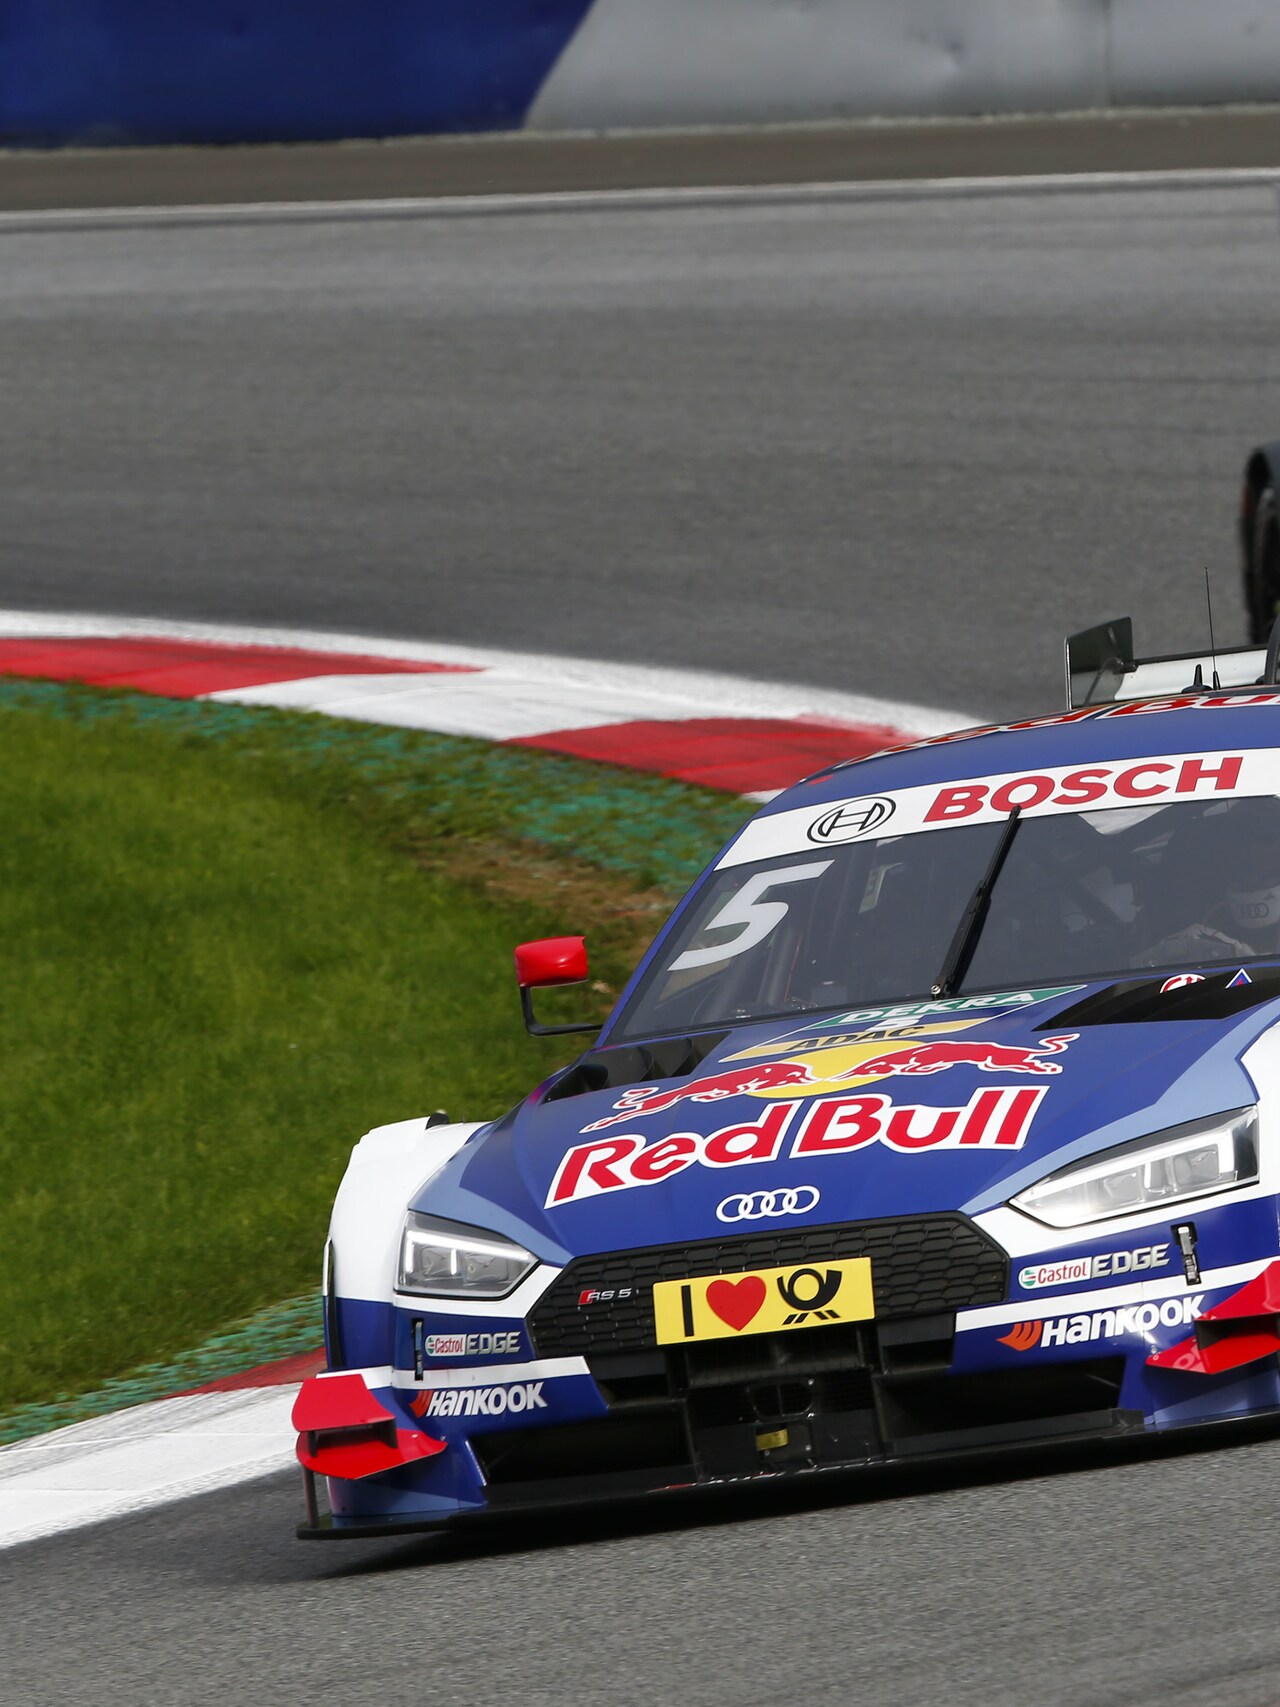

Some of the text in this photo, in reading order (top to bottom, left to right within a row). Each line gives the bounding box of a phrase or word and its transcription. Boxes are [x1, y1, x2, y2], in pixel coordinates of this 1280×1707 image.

[923, 756, 1243, 823] BOSCH
[667, 860, 835, 971] 5
[839, 992, 1035, 1024] DEKRA
[786, 1026, 927, 1050] ADAC
[548, 1087, 1046, 1206] Red Bull
[1037, 1243, 1171, 1285] Castrol EDGE
[681, 1285, 695, 1337] I
[435, 1331, 521, 1355] Castrol EDGE
